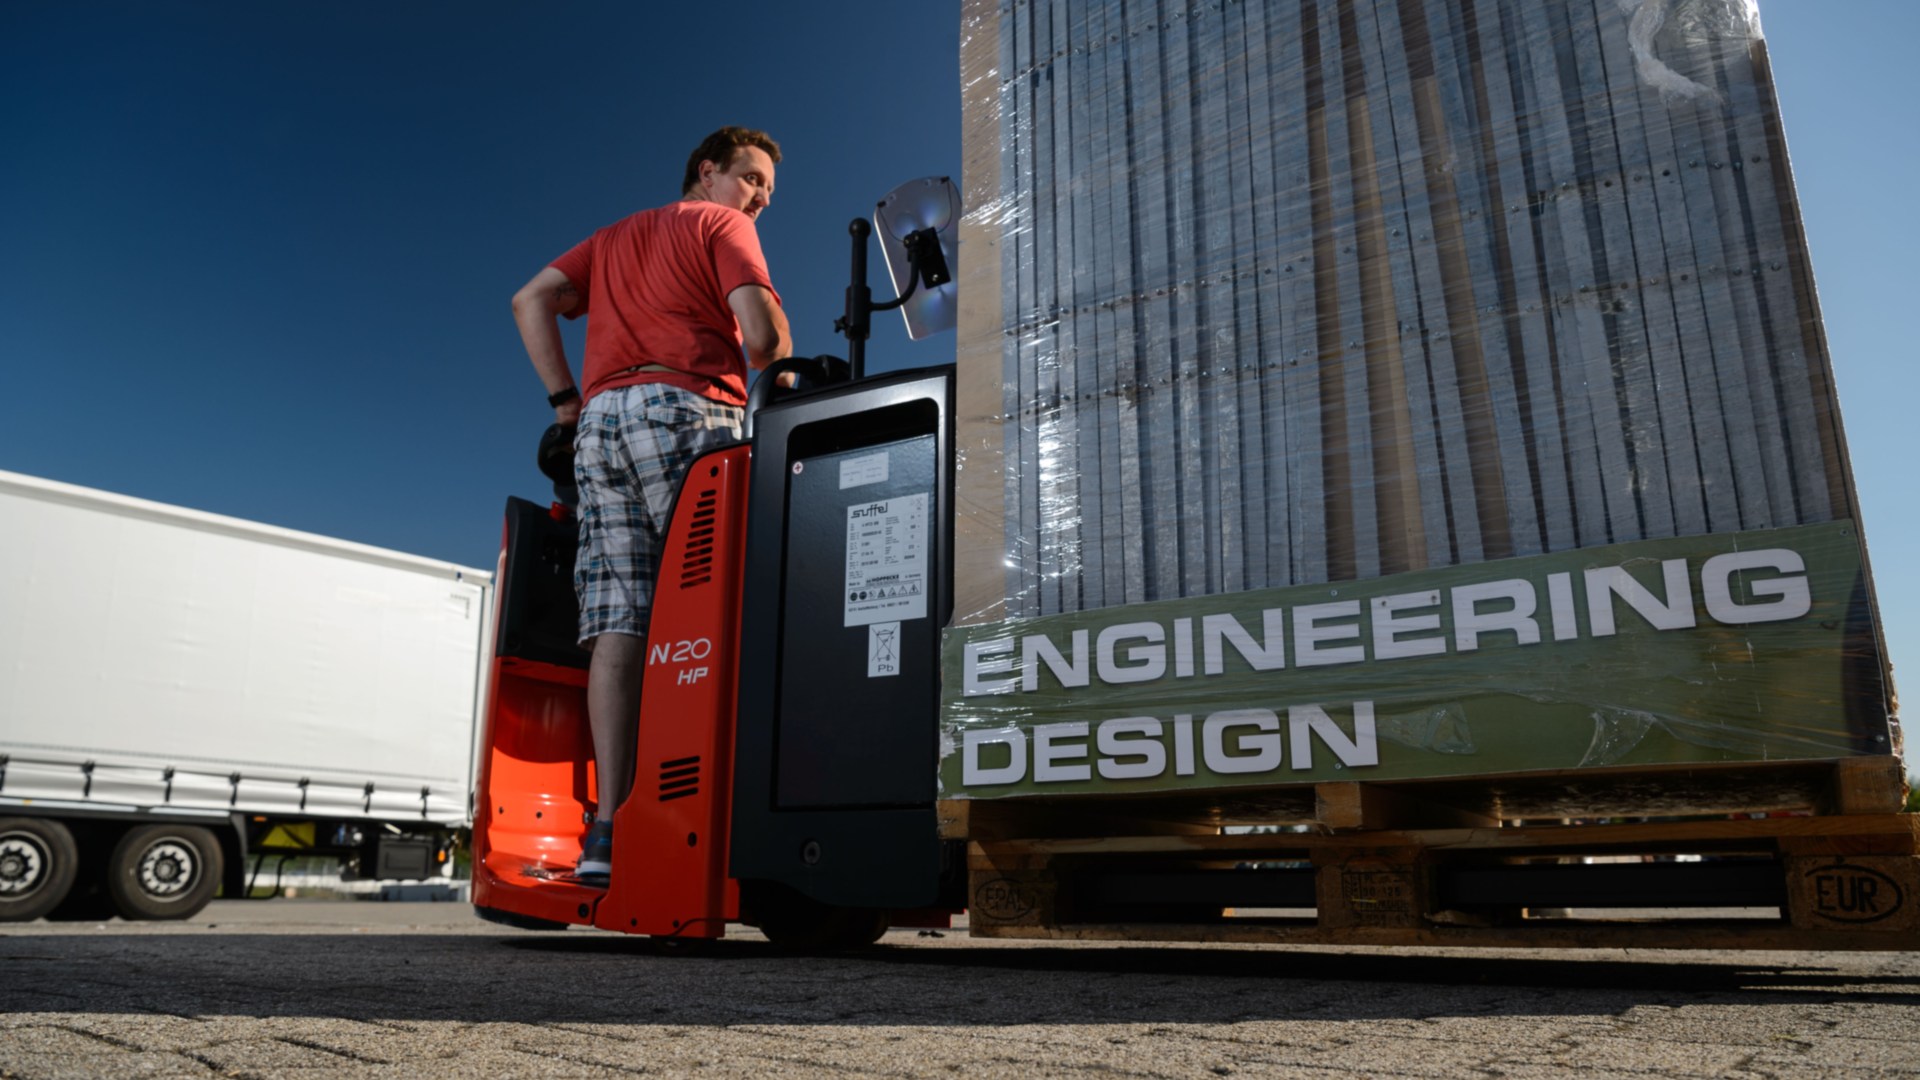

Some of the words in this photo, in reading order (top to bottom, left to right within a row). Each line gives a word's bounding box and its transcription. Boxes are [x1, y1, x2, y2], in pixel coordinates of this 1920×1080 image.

[850, 502, 888, 518] suffel
[963, 548, 1811, 697] ENGINEERING
[677, 667, 708, 685] HP
[877, 664, 893, 672] Pb
[962, 701, 1379, 786] DESIGN
[1816, 876, 1877, 912] EUR
